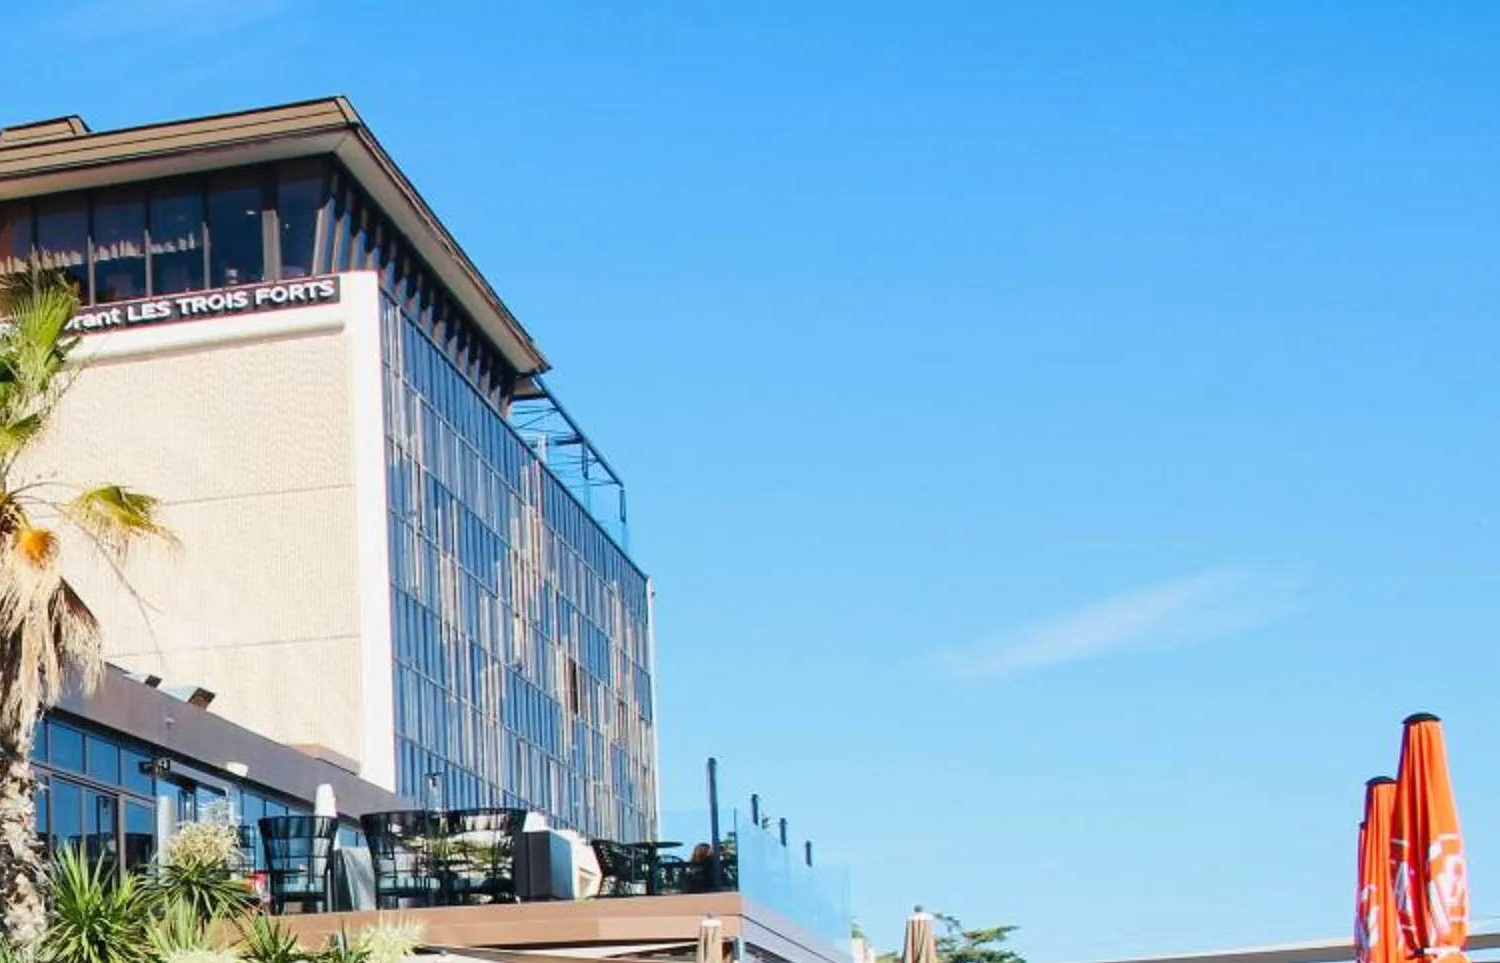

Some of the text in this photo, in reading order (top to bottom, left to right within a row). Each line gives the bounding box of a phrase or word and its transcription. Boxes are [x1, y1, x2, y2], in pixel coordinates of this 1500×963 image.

[126, 301, 172, 322] LES
[176, 290, 248, 316] TROIS
[255, 279, 335, 305] FORTS
